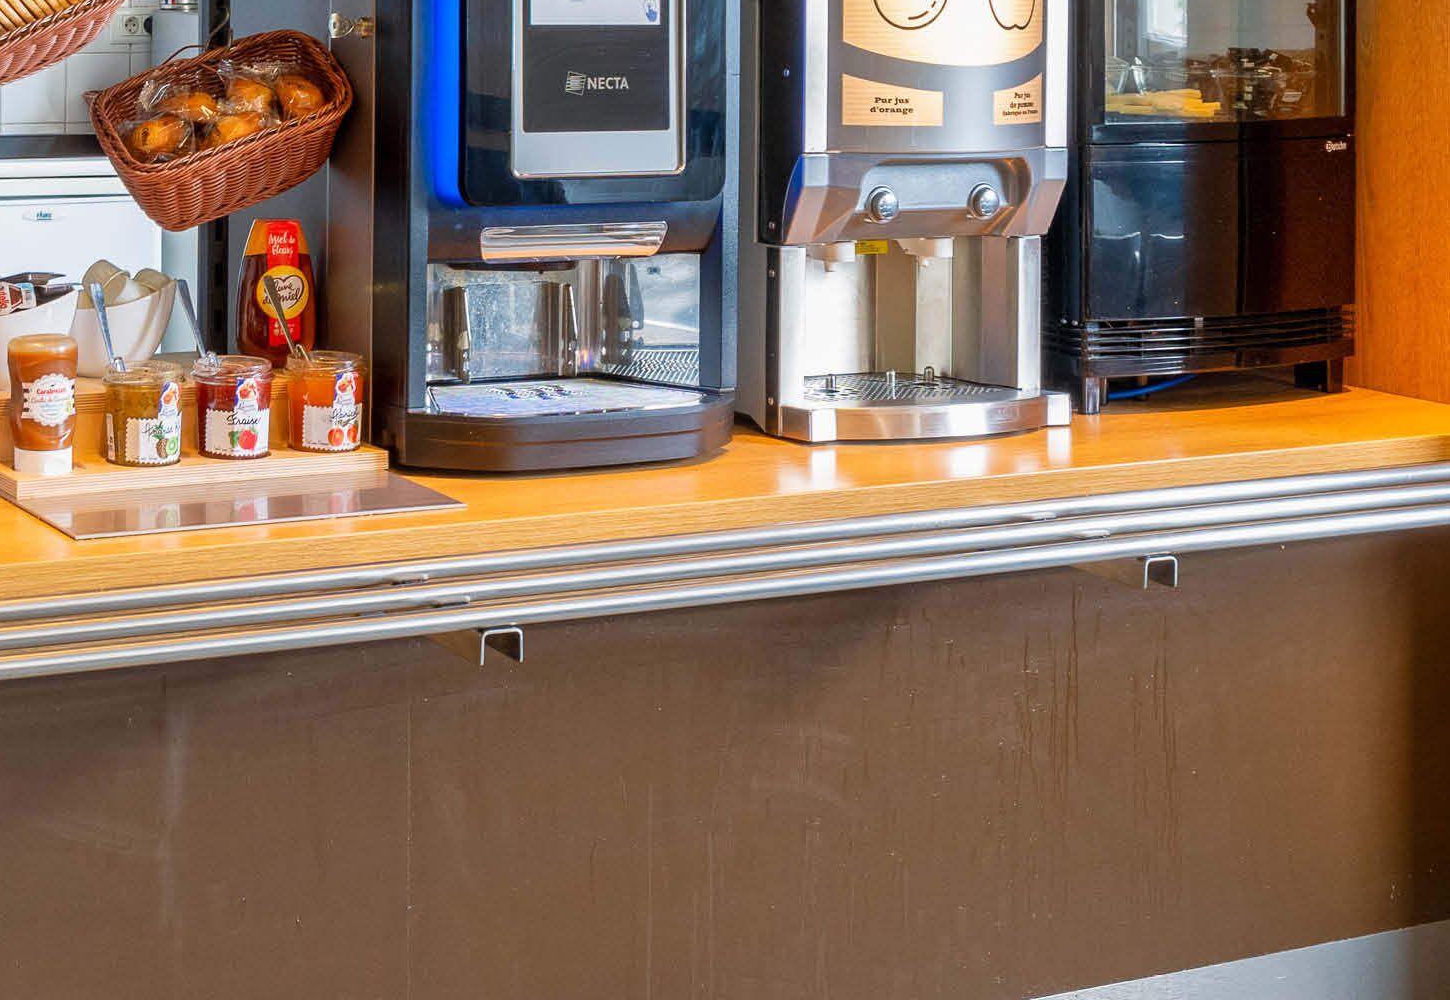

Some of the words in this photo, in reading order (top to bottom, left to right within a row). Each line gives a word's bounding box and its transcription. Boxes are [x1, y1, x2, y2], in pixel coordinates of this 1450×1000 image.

[587, 76, 629, 91] NECTA
[874, 96, 893, 104] Pur
[894, 96, 910, 106] jus
[869, 106, 914, 116] d'orange
[269, 230, 288, 245] Miel
[226, 412, 261, 426] Fraise
